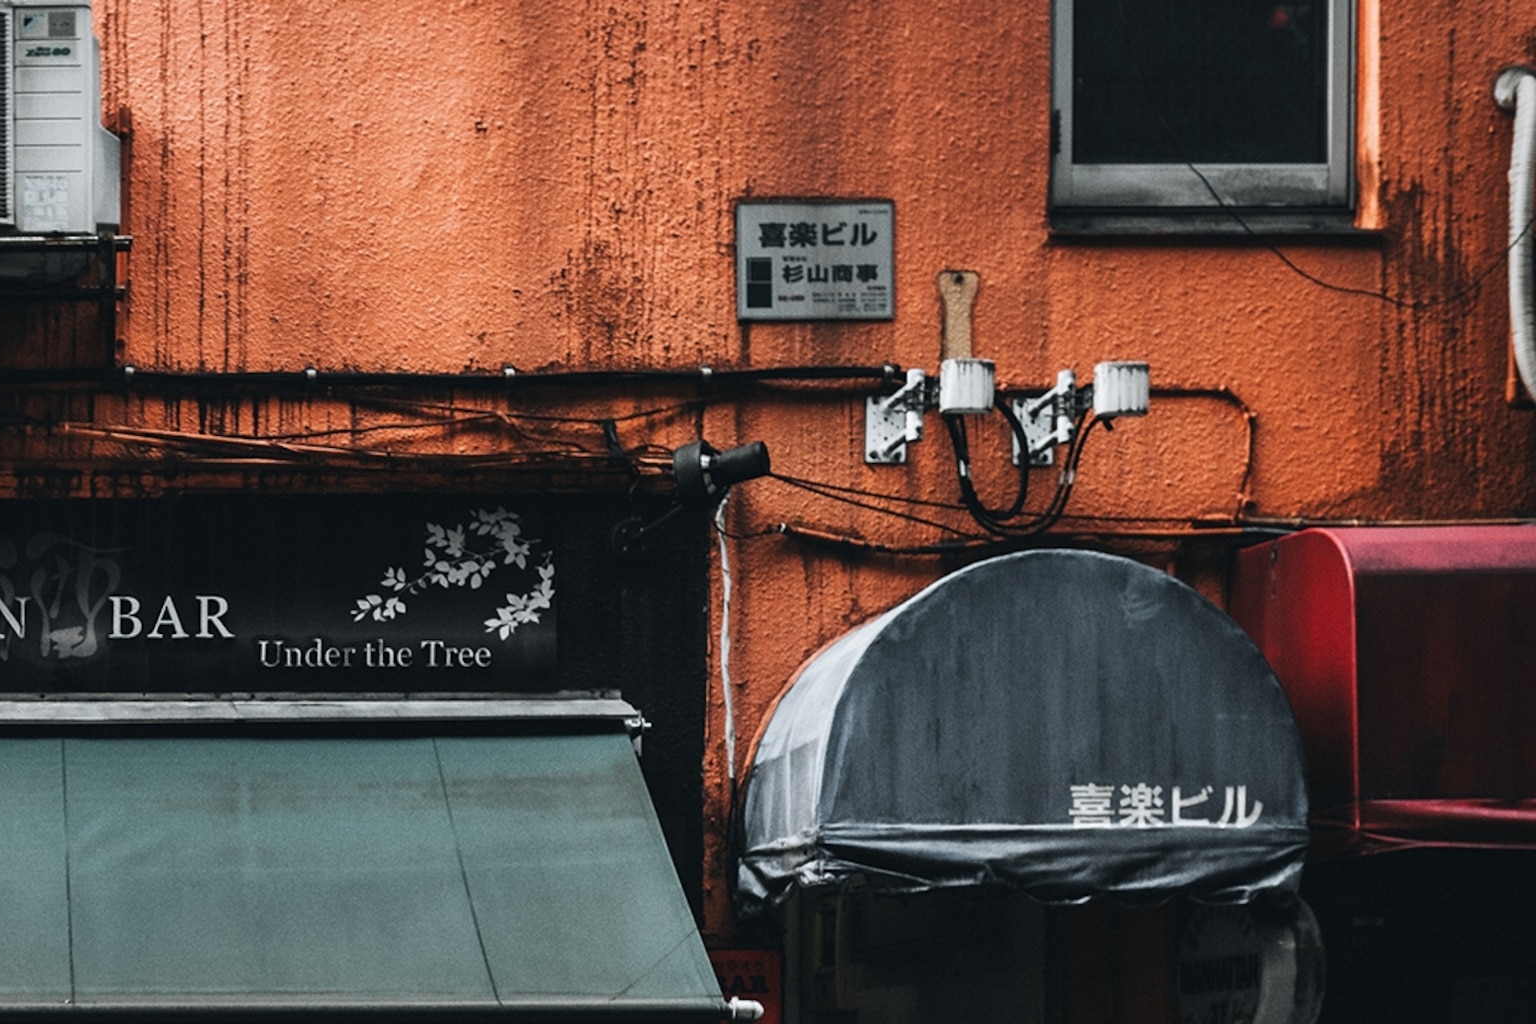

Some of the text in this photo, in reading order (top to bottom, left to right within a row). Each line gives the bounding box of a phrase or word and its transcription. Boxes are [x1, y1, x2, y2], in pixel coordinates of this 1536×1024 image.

[759, 221, 877, 248] 喜楽ビル
[782, 264, 878, 284] 杉山商事
[108, 595, 235, 638] BAR
[258, 638, 492, 668] Under the Tree
[1069, 783, 1263, 828] 喜楽ビル
